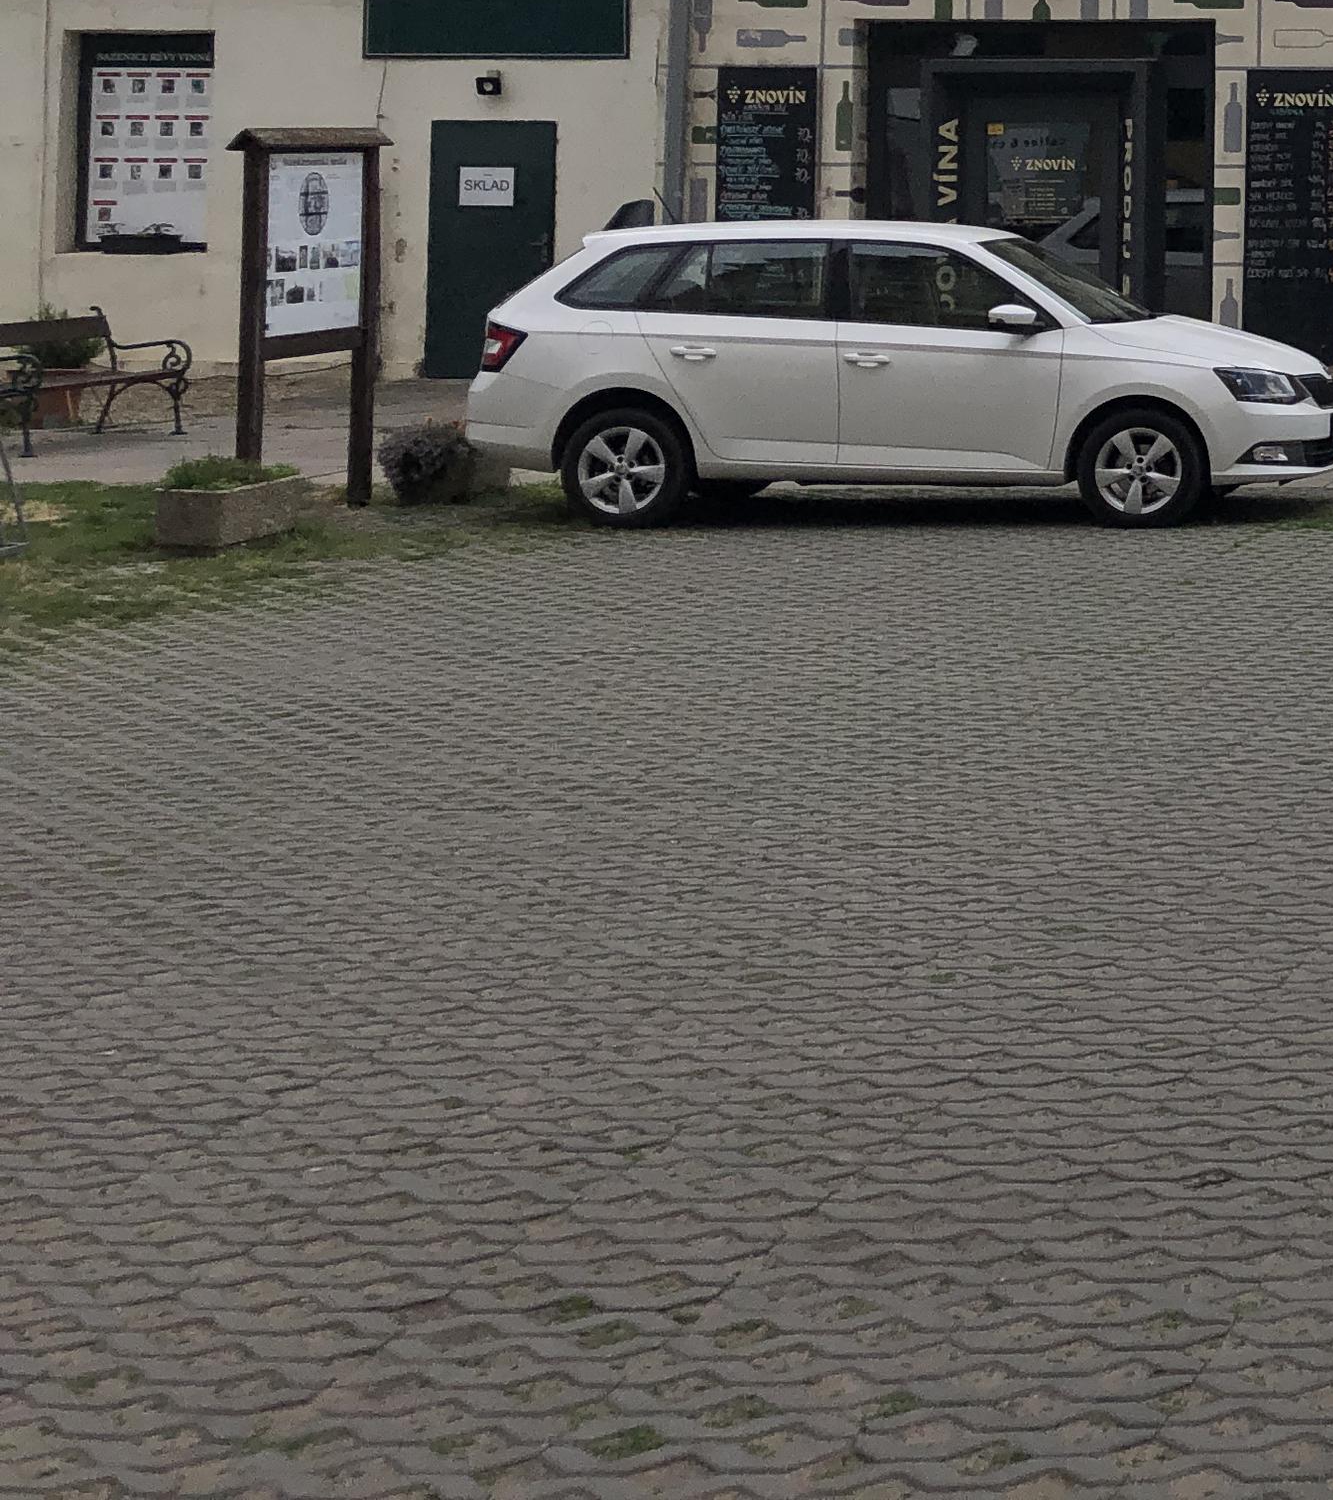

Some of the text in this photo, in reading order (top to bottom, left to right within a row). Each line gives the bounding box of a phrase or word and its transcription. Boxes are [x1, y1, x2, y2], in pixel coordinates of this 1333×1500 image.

[744, 86, 807, 104] ZNOVÍN
[933, 118, 960, 207] VÍNA
[1025, 156, 1076, 171] ZNOVÍN
[463, 179, 510, 192] SKLAD
